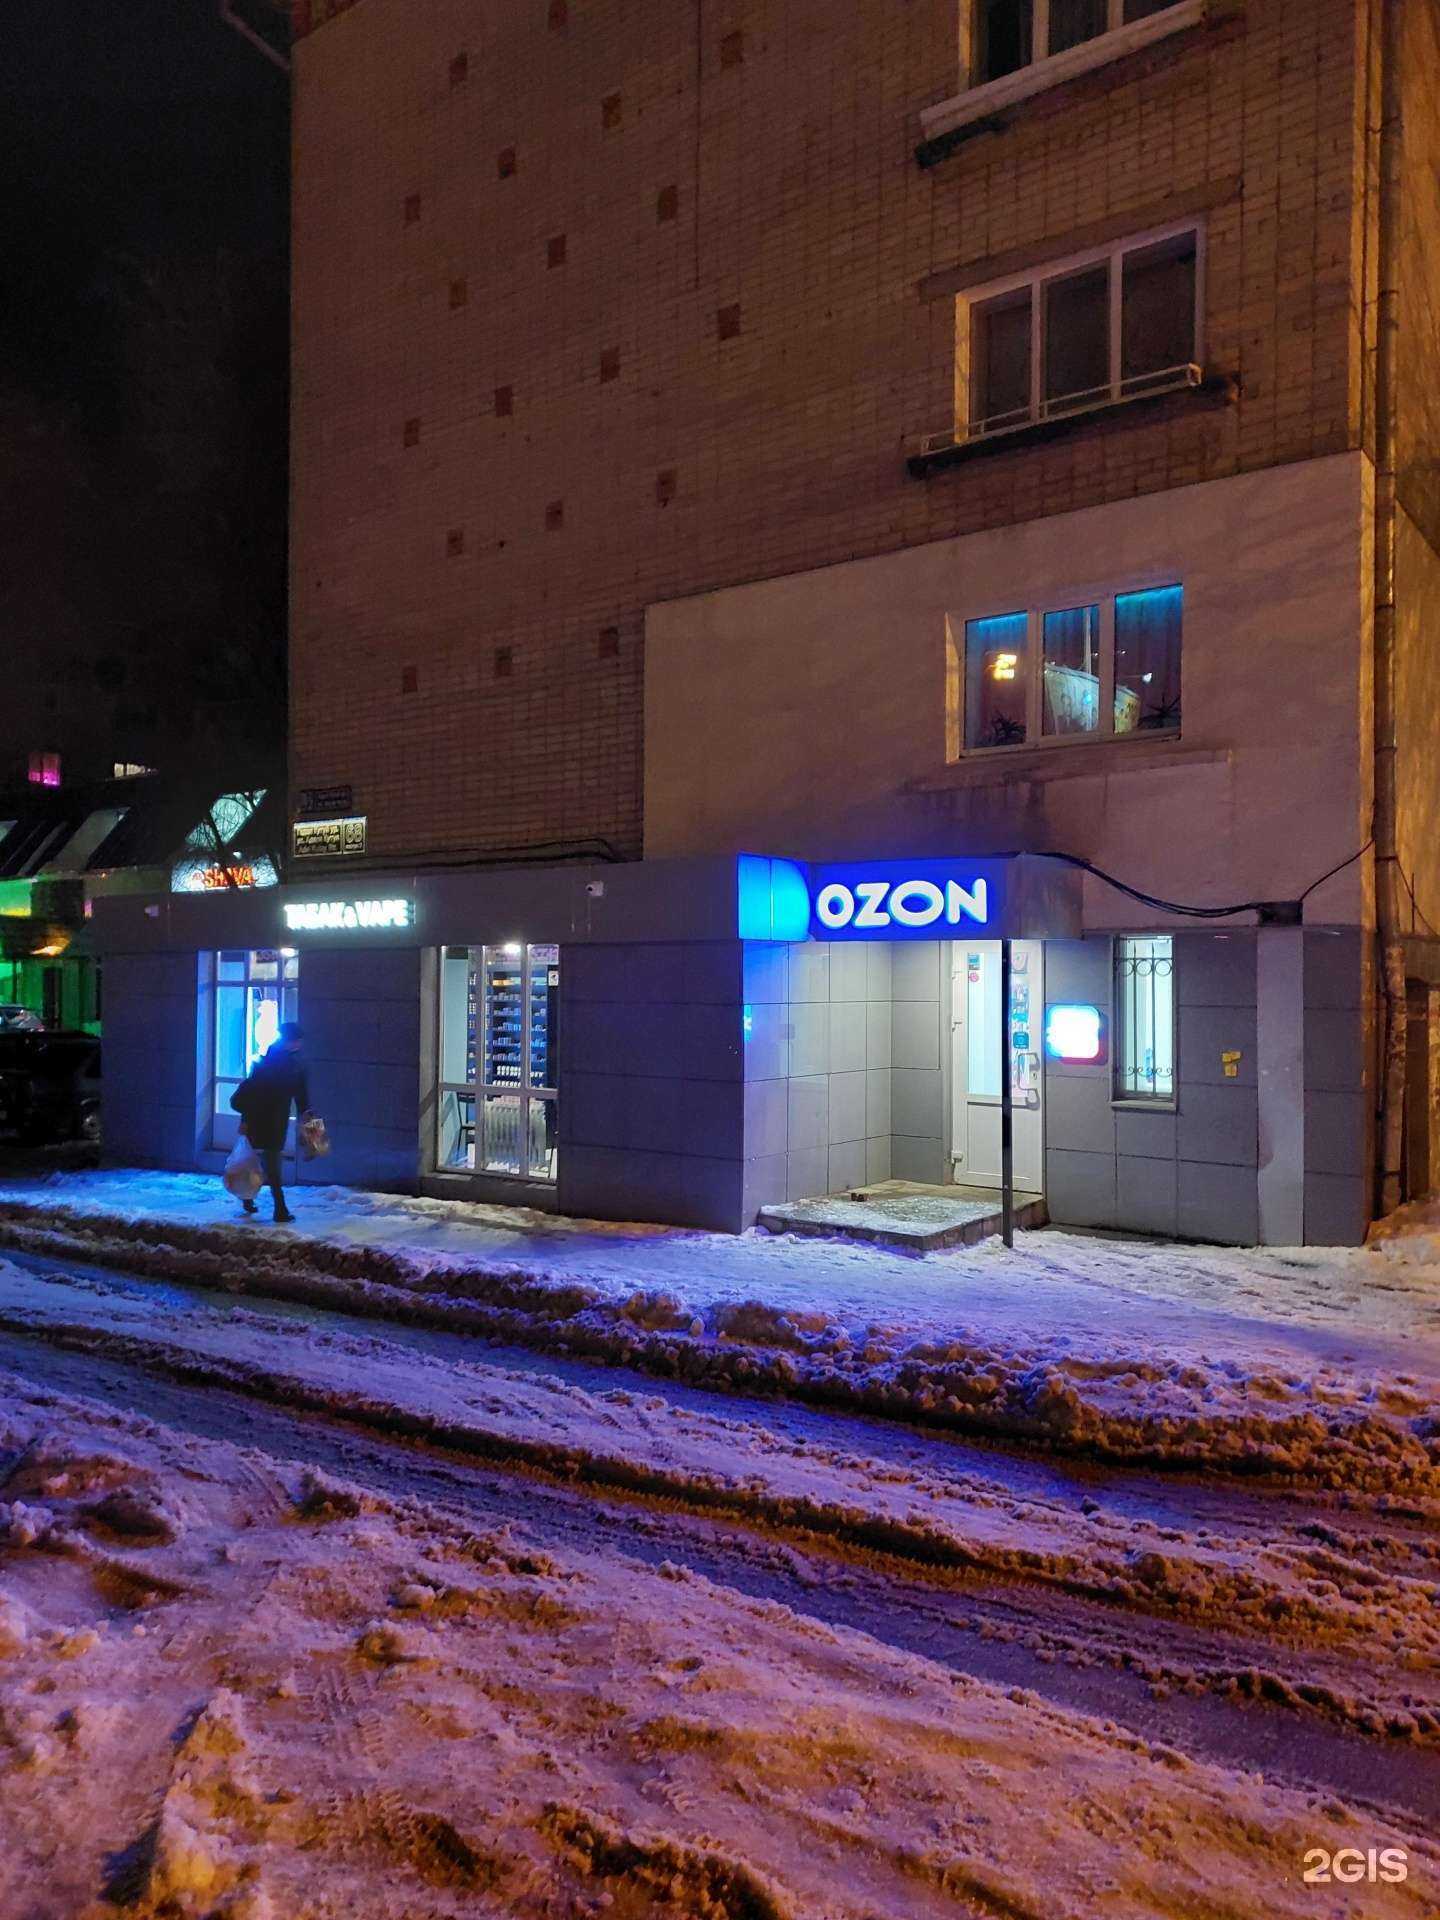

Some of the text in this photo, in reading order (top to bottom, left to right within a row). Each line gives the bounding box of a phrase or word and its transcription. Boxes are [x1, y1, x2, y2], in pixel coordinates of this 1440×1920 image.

[204, 866, 255, 888] SHVA
[356, 900, 408, 927] VAPE
[816, 878, 988, 929] OZON
